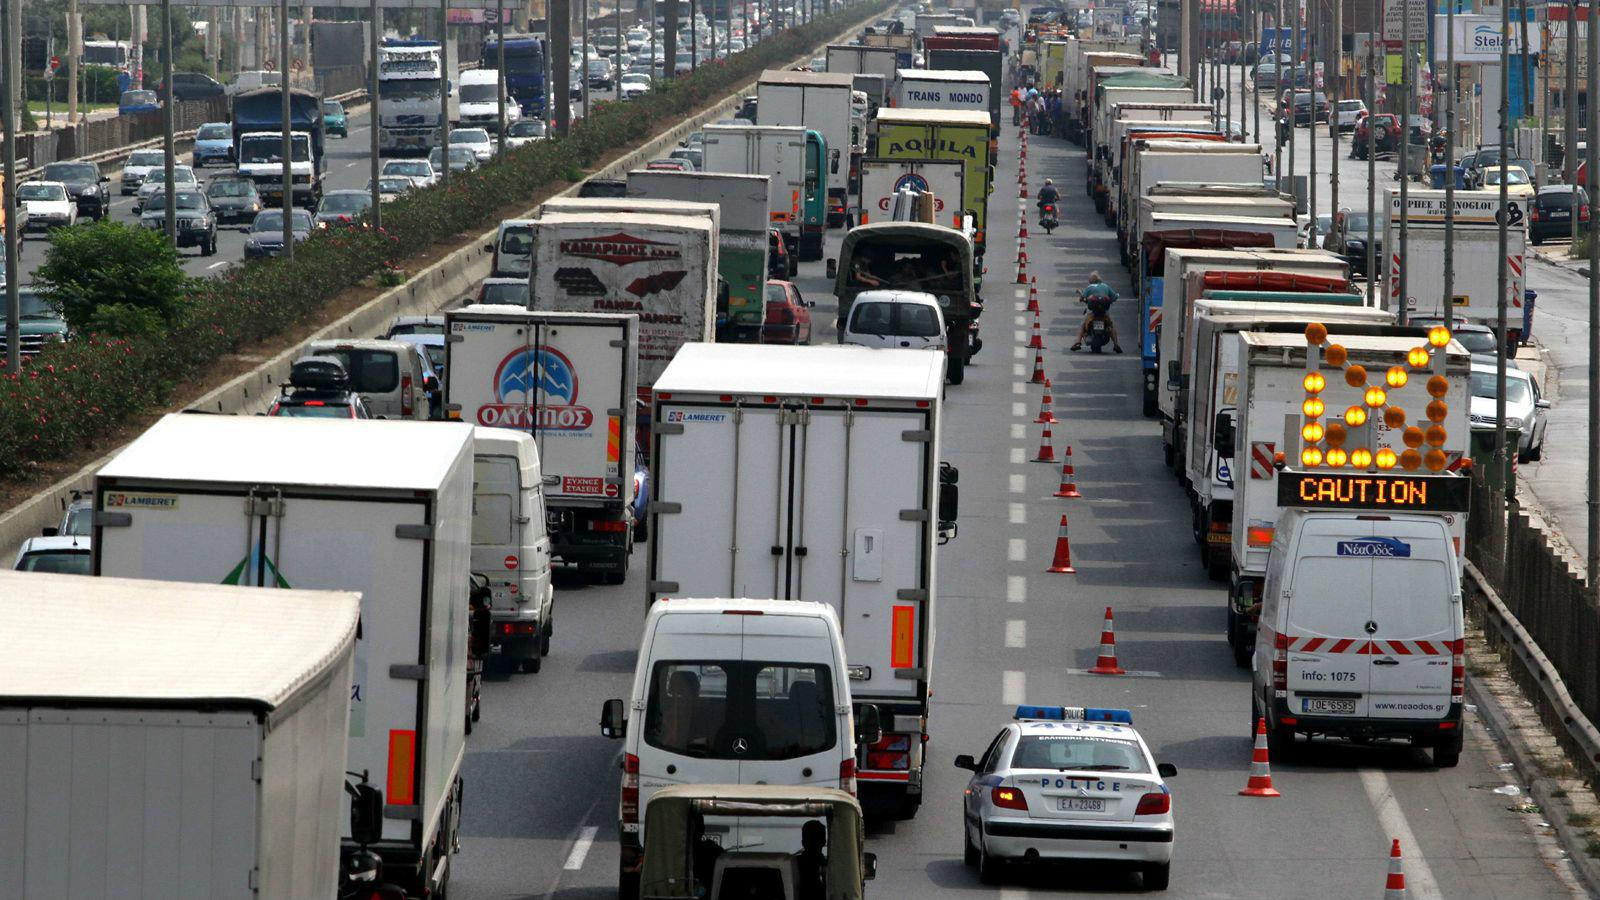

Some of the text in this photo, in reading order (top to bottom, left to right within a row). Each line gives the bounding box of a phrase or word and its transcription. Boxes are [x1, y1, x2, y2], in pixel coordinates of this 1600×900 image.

[908, 91, 983, 104] TRANS MONDO
[889, 139, 976, 158] AQUILA
[1393, 200, 1433, 209] OPHEE
[683, 414, 726, 422] LAMBERET
[1300, 478, 1427, 504] CAUTION
[125, 496, 176, 505] LAMBERET
[1302, 670, 1356, 681] info: 1075
[1375, 703, 1445, 712] www.neaodos.gr
[1064, 708, 1084, 719] POLICE
[1041, 778, 1120, 791] POLICE
